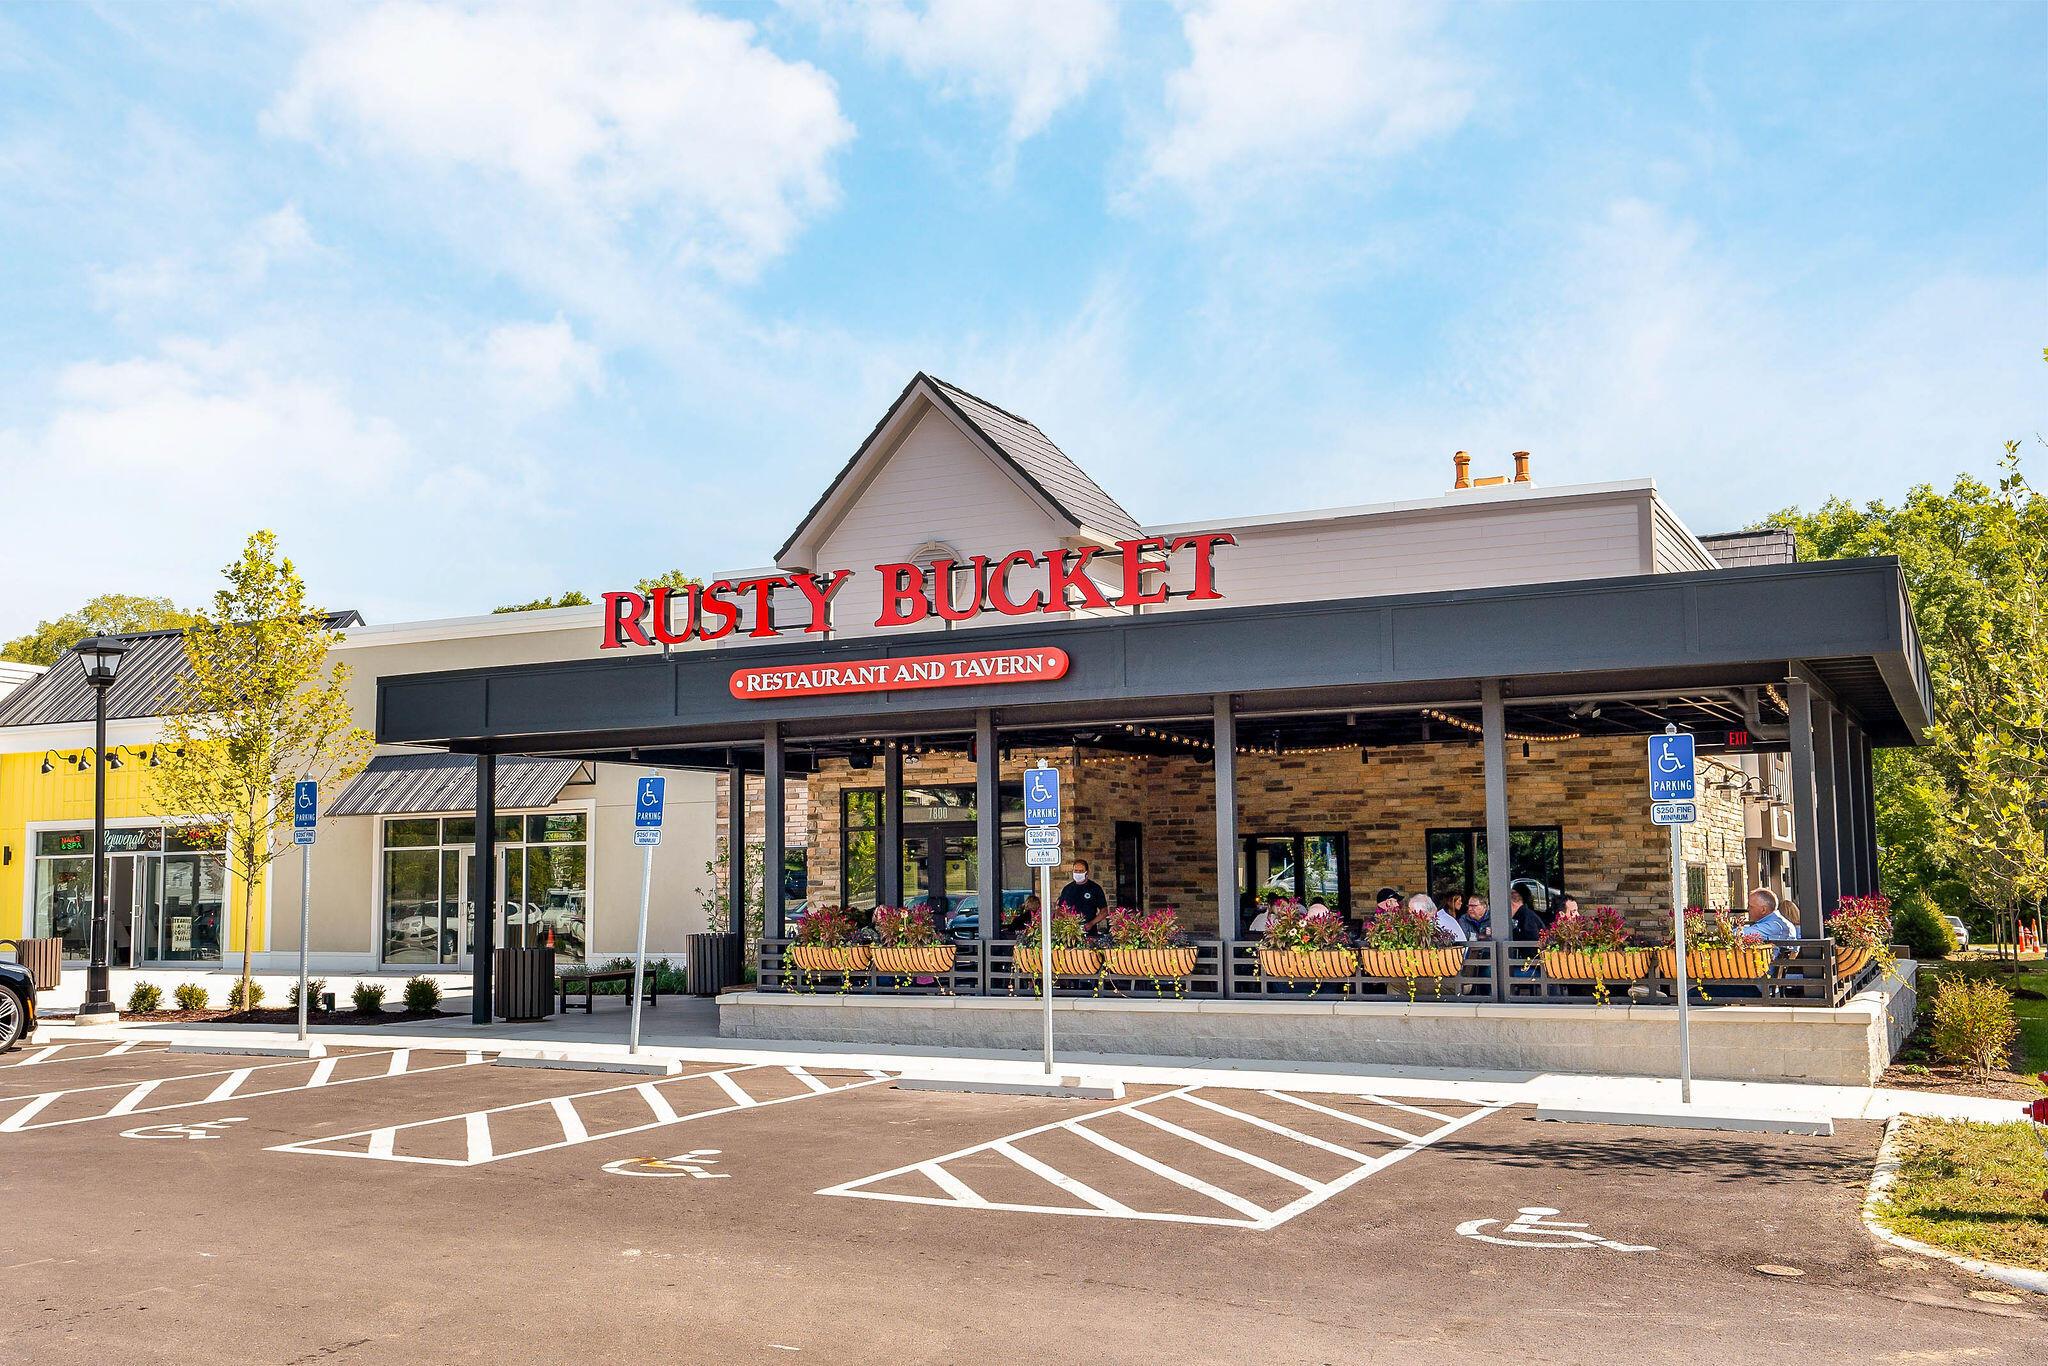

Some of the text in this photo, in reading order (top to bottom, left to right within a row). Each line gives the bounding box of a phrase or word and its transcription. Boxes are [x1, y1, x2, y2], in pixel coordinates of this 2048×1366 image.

[600, 533, 1236, 649] RUSTY BUCKET
[746, 654, 1044, 692] RESTAURANT AND TAVERN
[1729, 731, 1748, 746] EXIT
[1653, 779, 1692, 791] PARKING
[928, 807, 948, 819] 7800
[1027, 808, 1057, 818] PARKING
[1656, 805, 1692, 814] $250 FINE
[295, 813, 316, 821] PARKING
[637, 811, 662, 821] PARKING
[61, 835, 81, 844] NAILS
[67, 842, 83, 850] SPA
